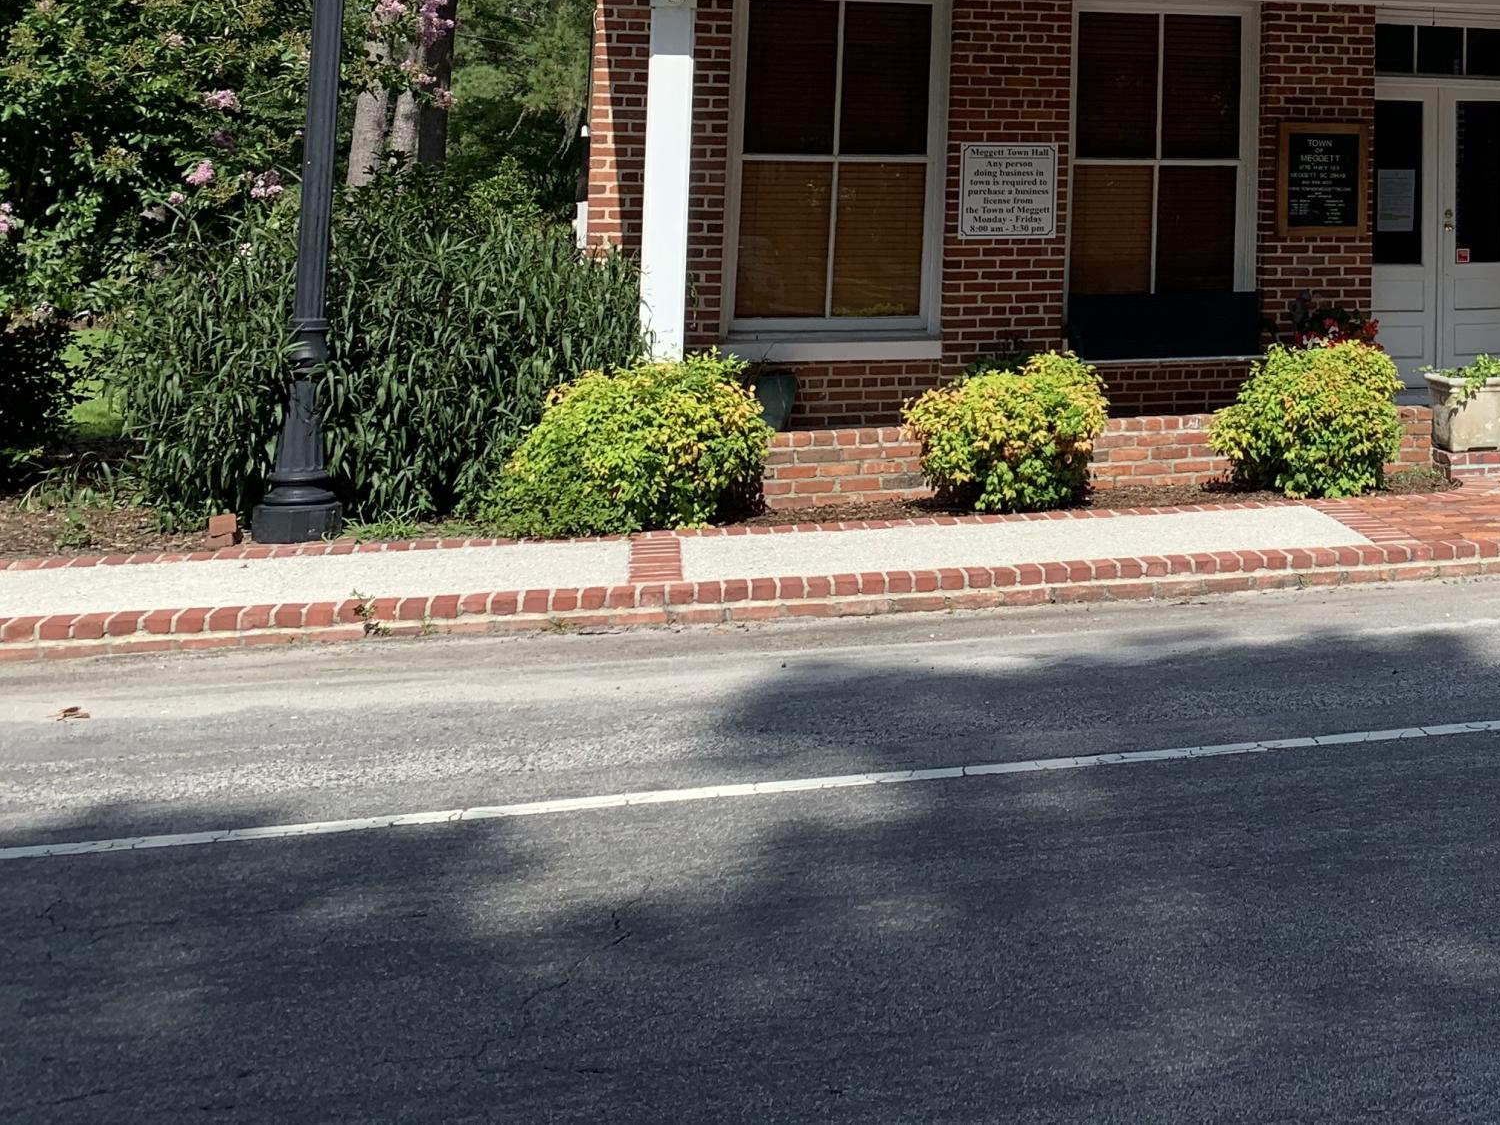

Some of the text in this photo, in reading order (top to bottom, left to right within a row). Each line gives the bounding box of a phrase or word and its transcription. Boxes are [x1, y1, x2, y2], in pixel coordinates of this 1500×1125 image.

[1307, 139, 1332, 147] TOWN
[971, 148, 1049, 157] Meggett Town Hall
[1300, 154, 1340, 162] MEGGETT
[986, 160, 1033, 169] Any person
[974, 169, 1044, 178] doing business in
[993, 178, 1000, 186] is
[1002, 178, 1037, 187] required
[967, 187, 1006, 197] purchase
[1015, 187, 1049, 195] business
[983, 196, 1033, 204] license from
[966, 206, 1050, 215] the Town of Meggett
[973, 215, 1006, 225] Monday
[1015, 215, 1042, 225] Friday
[1031, 226, 1045, 234] pm
